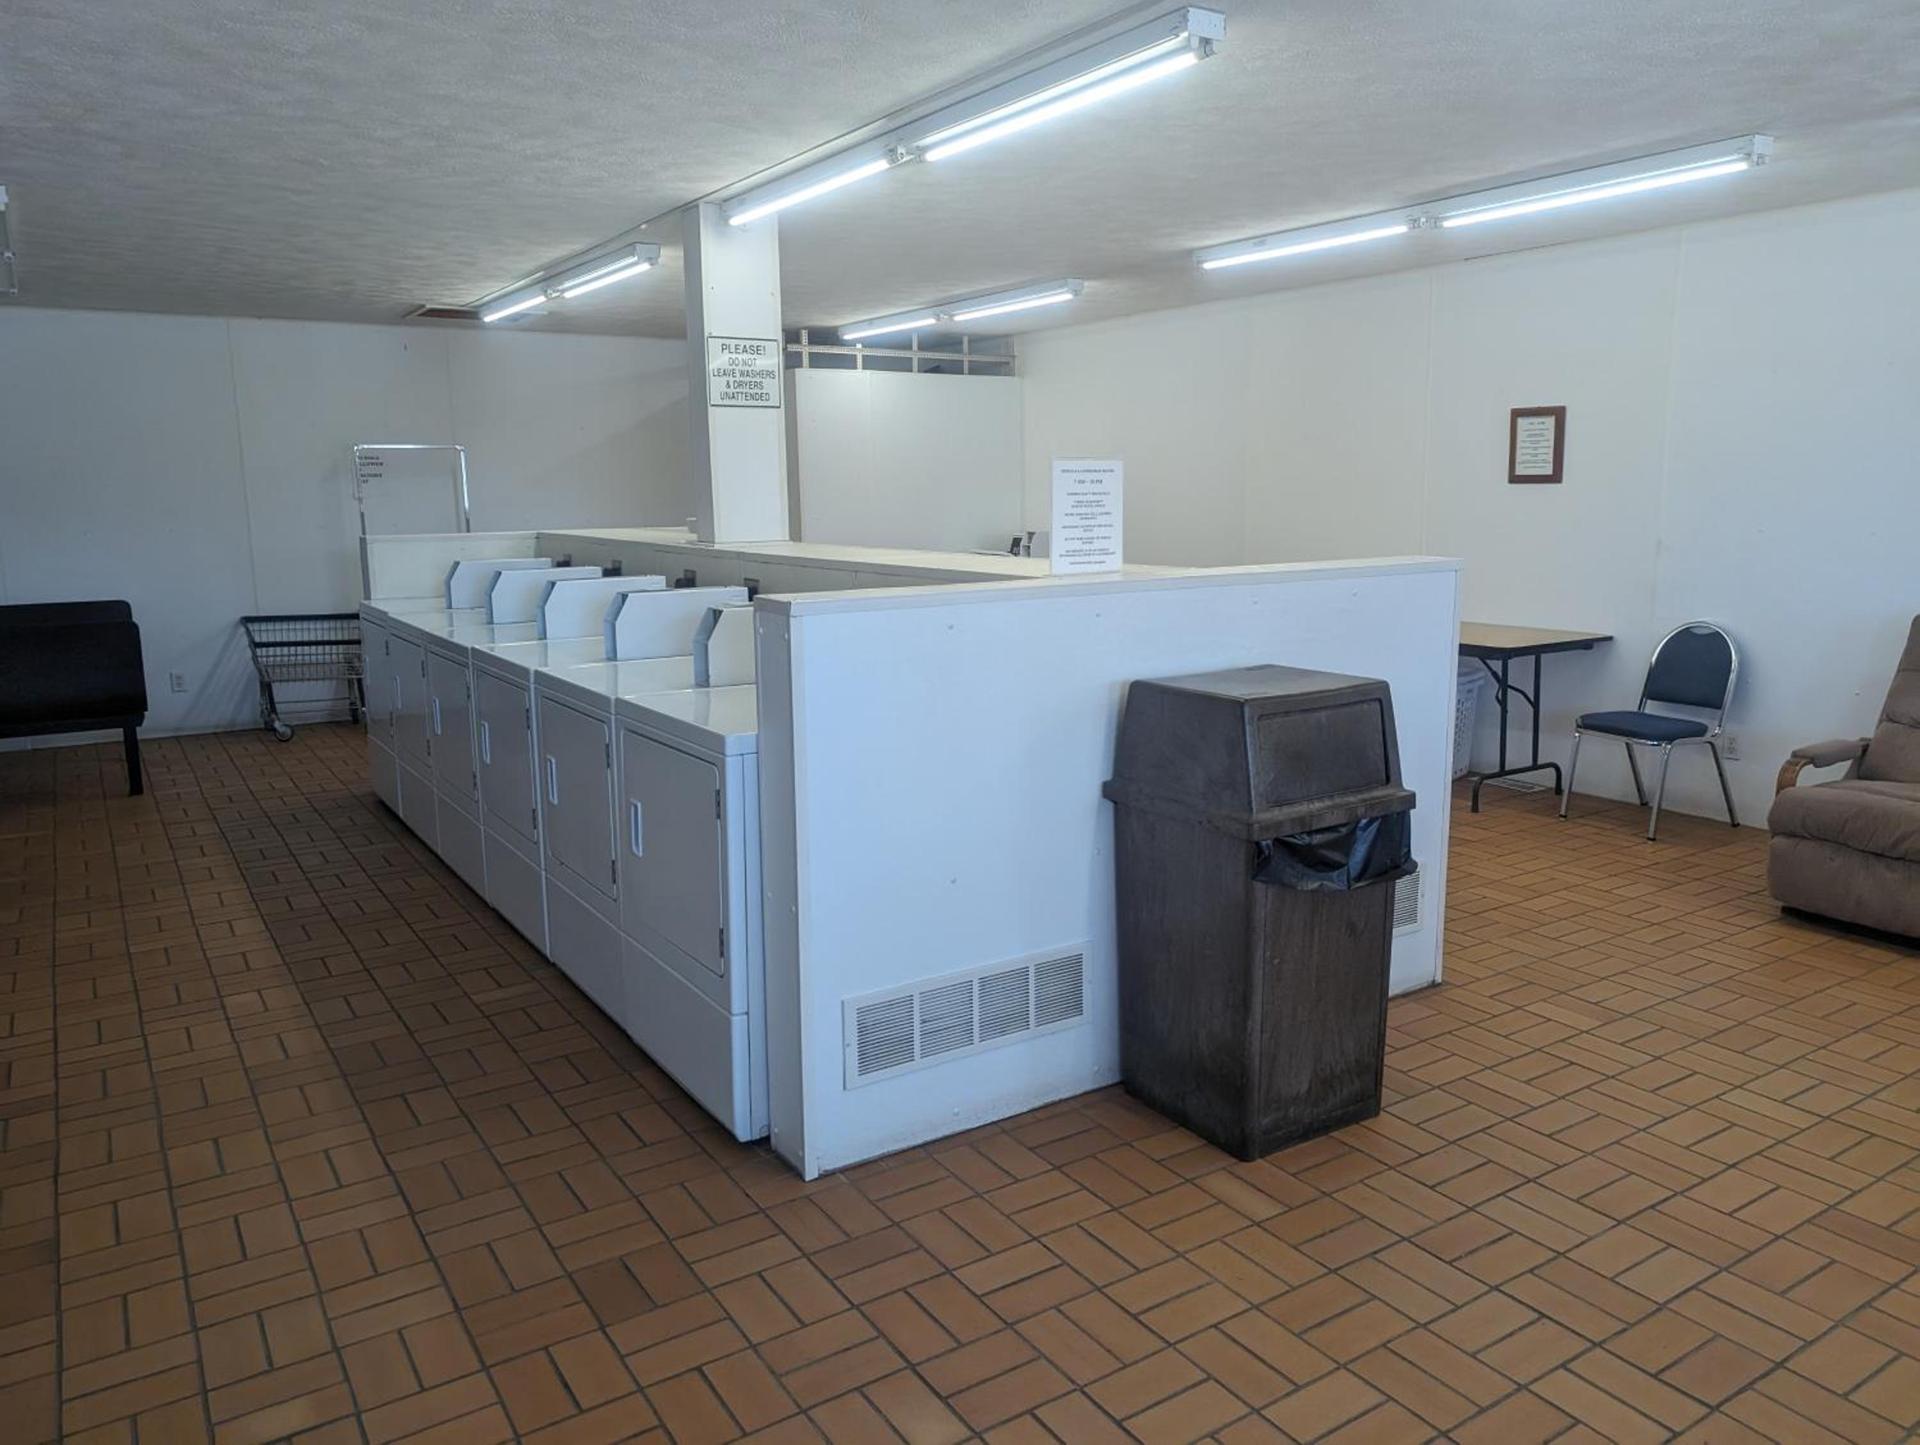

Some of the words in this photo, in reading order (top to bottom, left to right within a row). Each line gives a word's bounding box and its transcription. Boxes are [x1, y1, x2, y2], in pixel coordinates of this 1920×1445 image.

[721, 343, 766, 355] PLEASE!
[728, 357, 740, 366] DO
[741, 357, 757, 367] NOT
[712, 368, 737, 378] LEAVE
[738, 369, 776, 379] WASHERS
[725, 380, 731, 389] &
[733, 380, 764, 390] DRYERS
[720, 392, 770, 402] UNATTENDED
